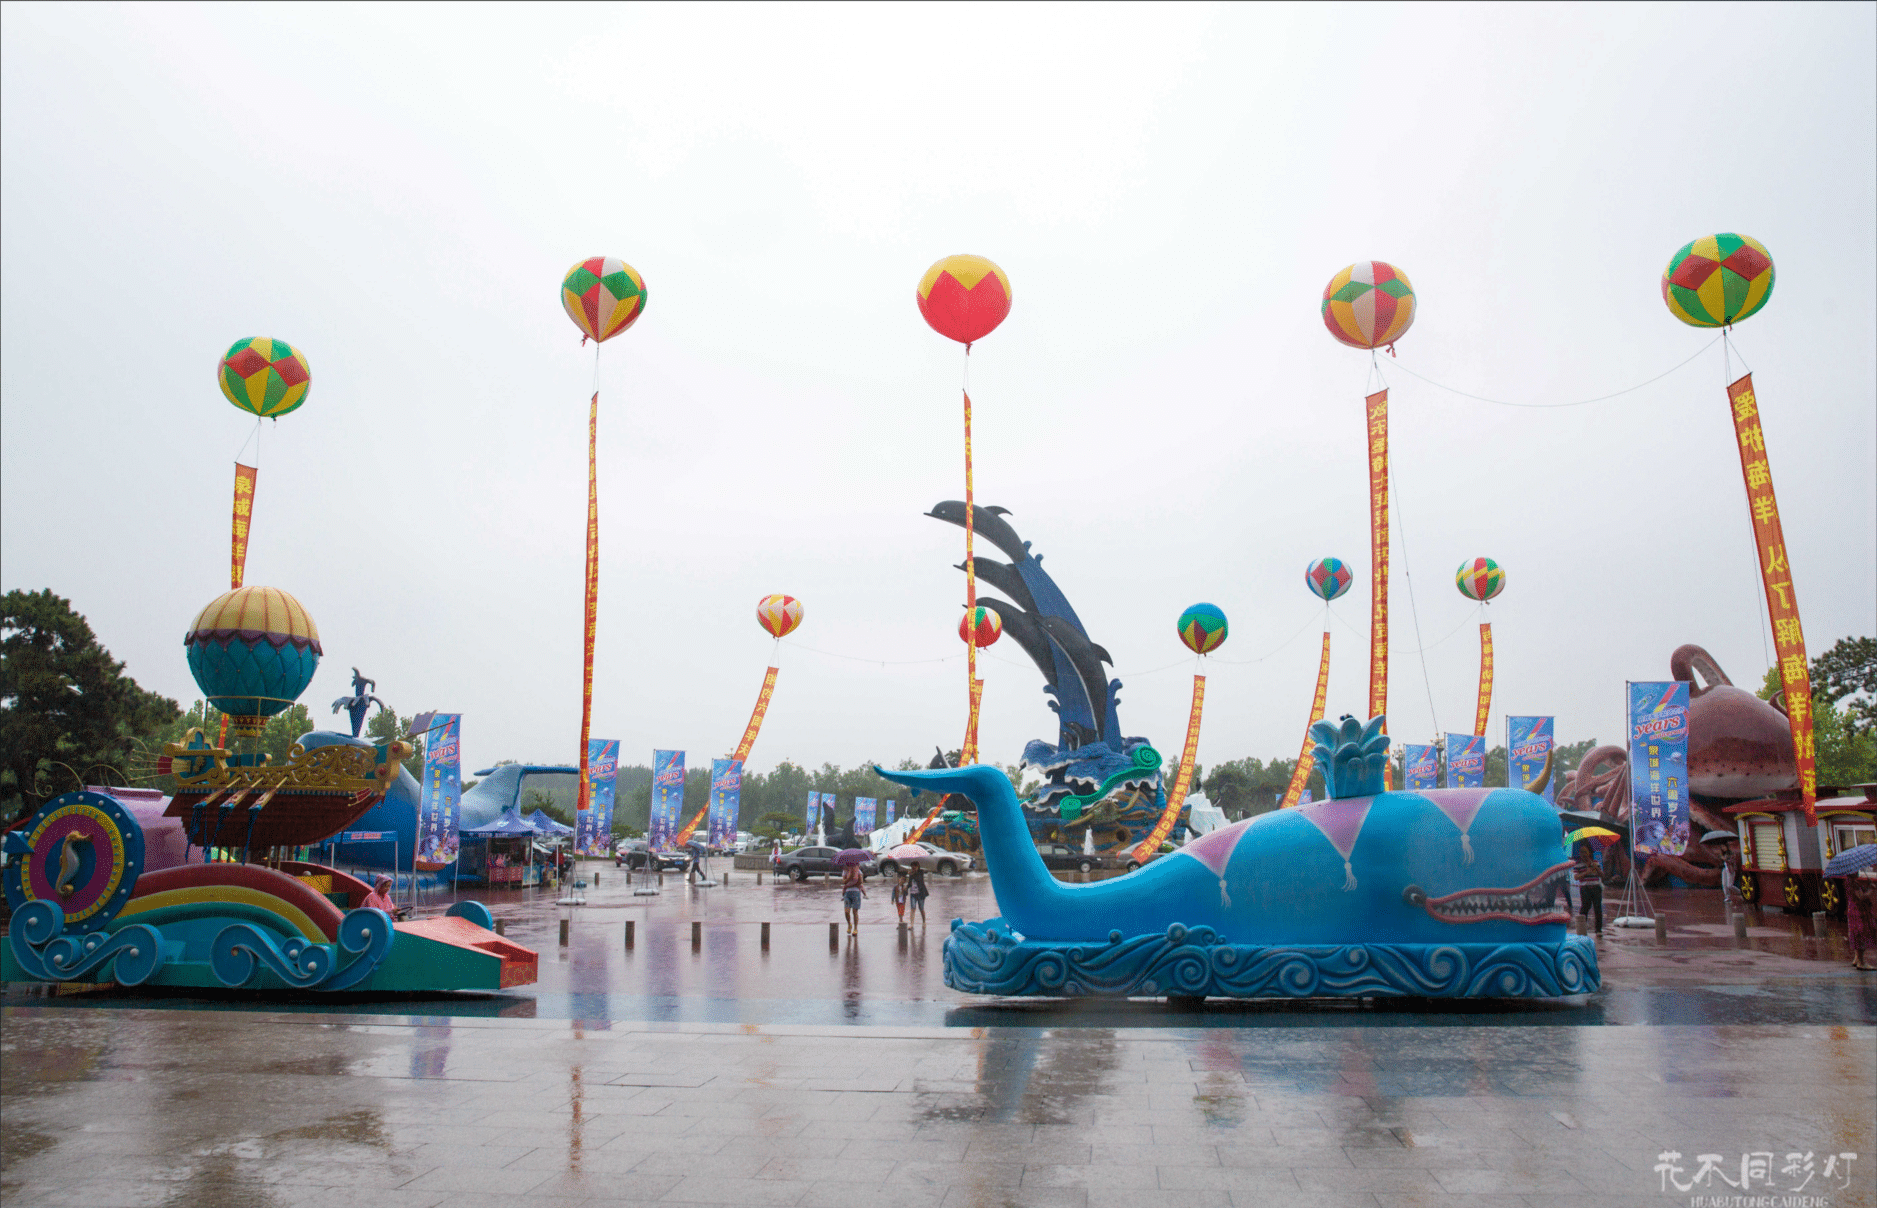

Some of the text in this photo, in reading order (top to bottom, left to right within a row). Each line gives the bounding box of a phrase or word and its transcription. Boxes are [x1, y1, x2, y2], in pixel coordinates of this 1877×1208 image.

[1633, 715, 1681, 740] years
[1511, 742, 1547, 760] years
[1450, 757, 1478, 771] years
